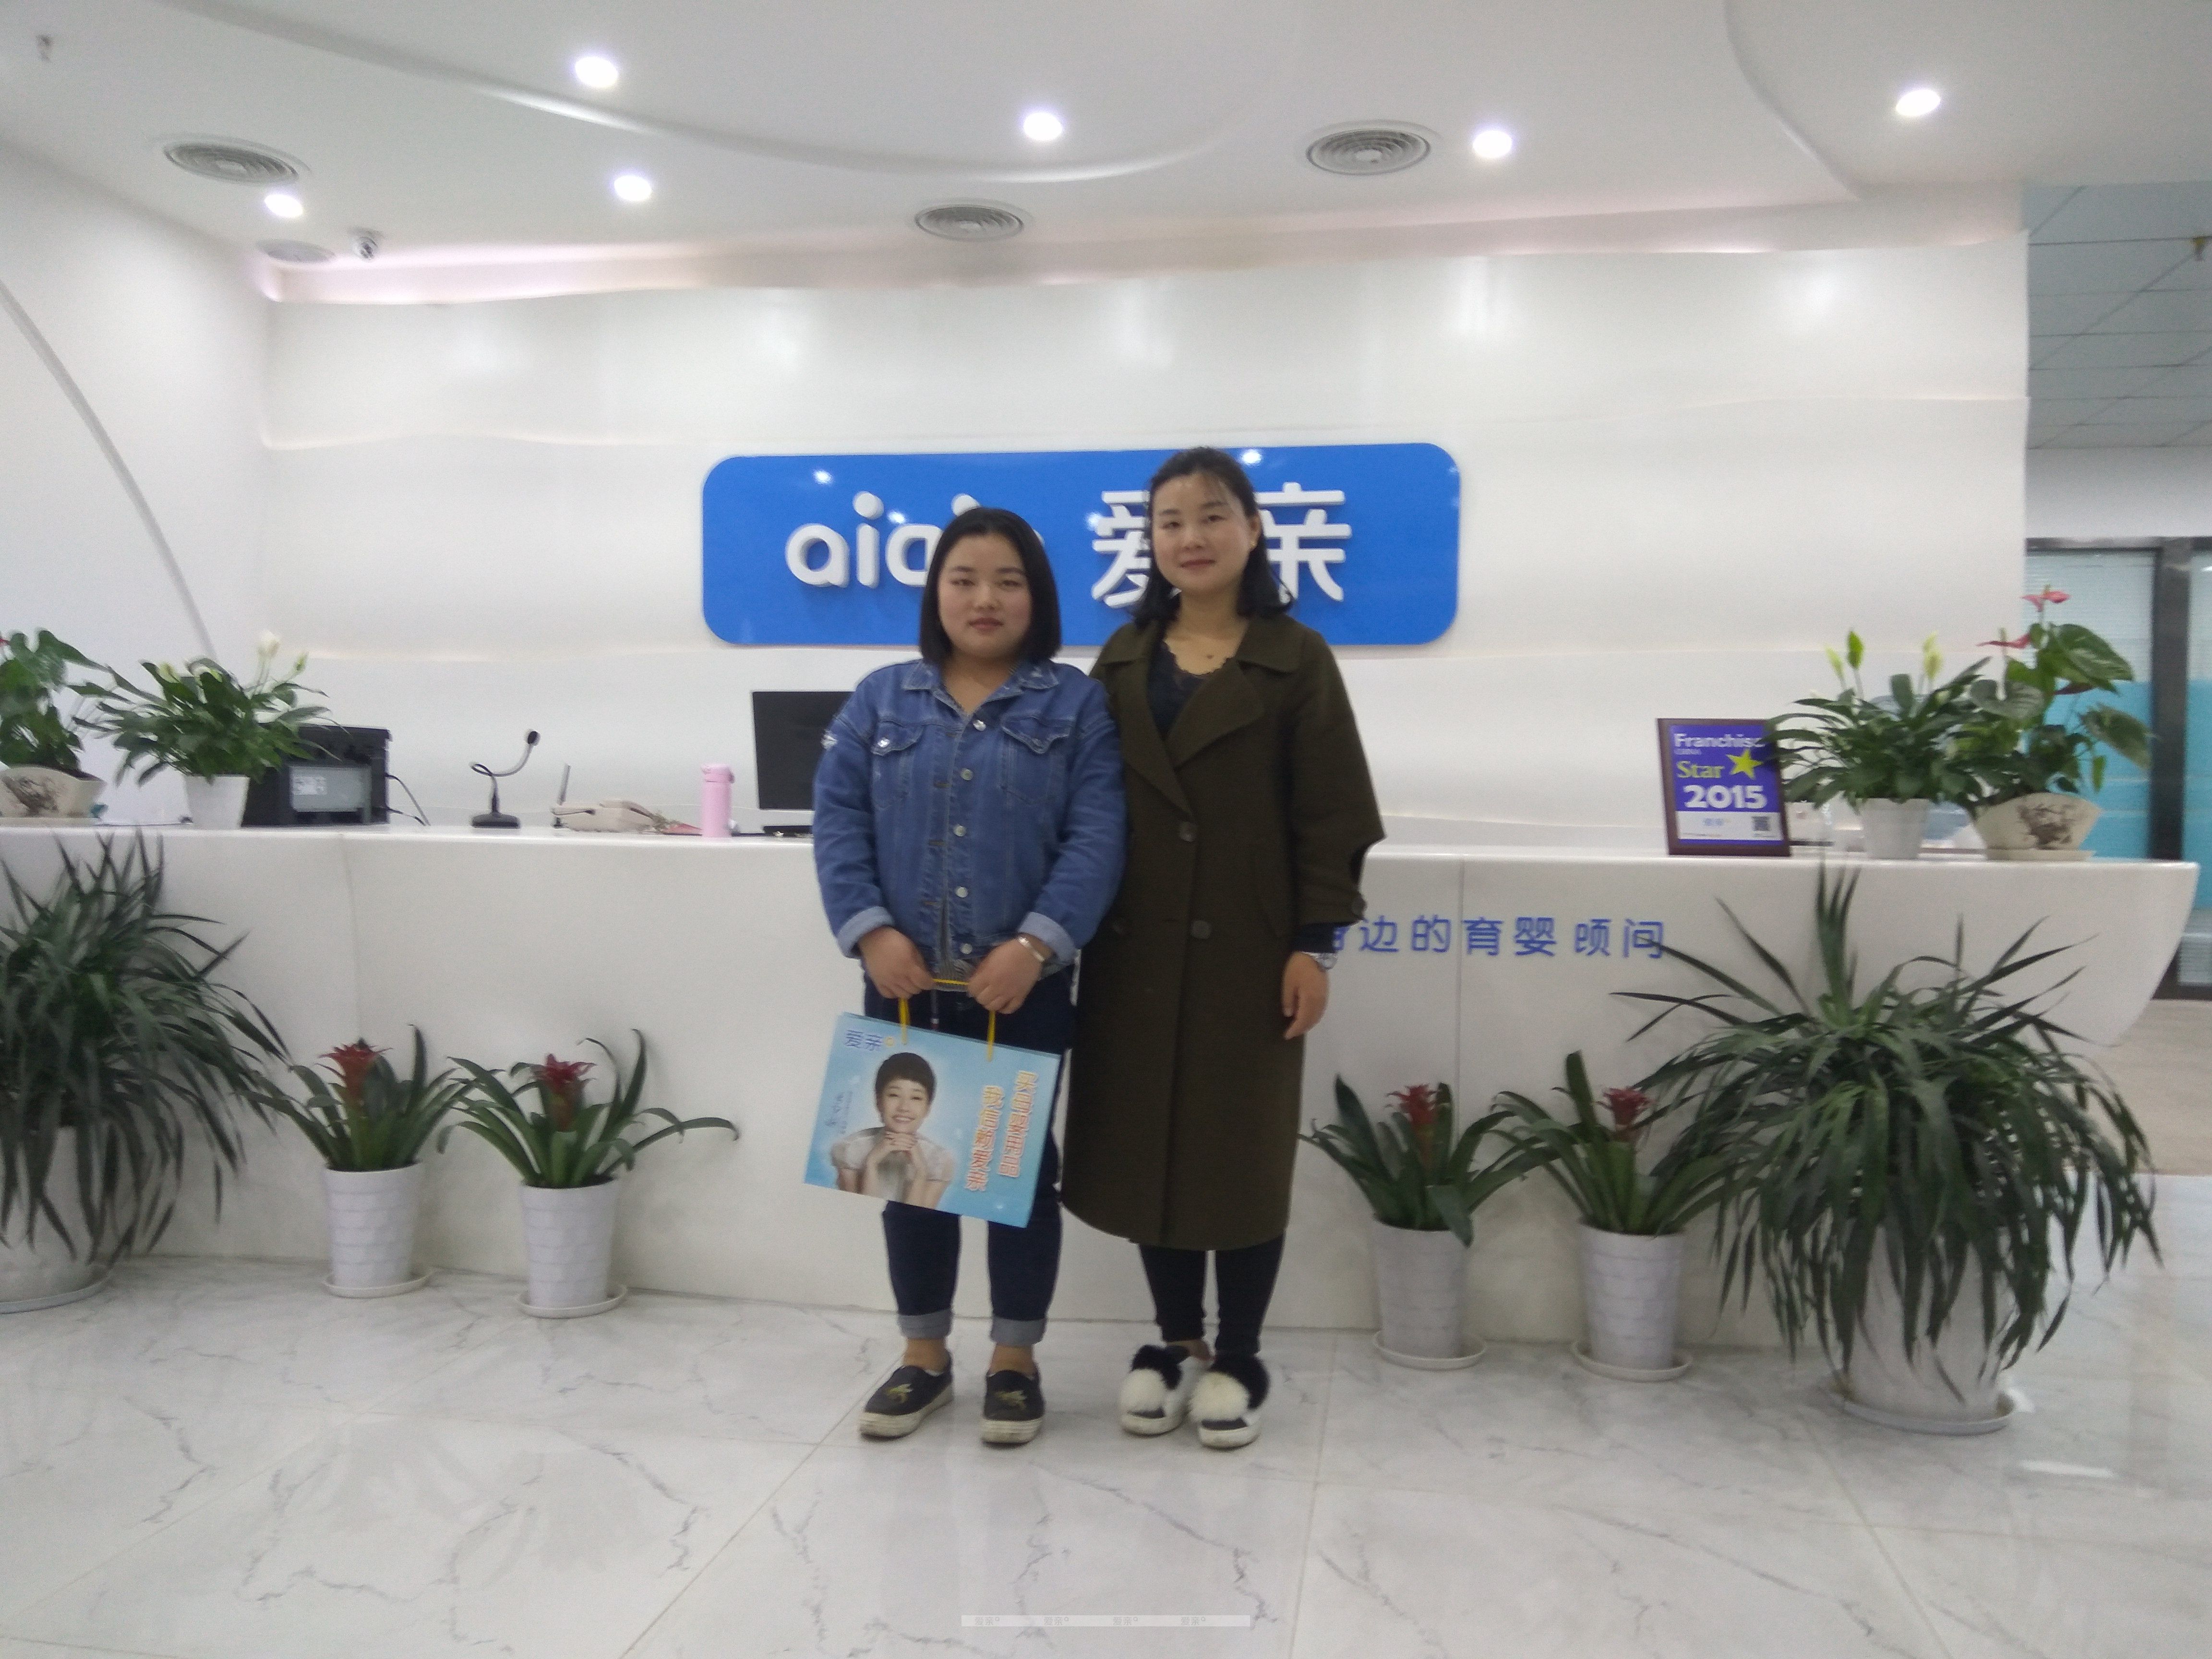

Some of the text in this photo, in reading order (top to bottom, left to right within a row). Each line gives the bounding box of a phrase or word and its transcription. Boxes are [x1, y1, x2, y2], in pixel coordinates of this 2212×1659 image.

[1674, 733, 1766, 747] Franchise
[1677, 760, 1725, 778] Star
[1683, 784, 1768, 809] 2015
